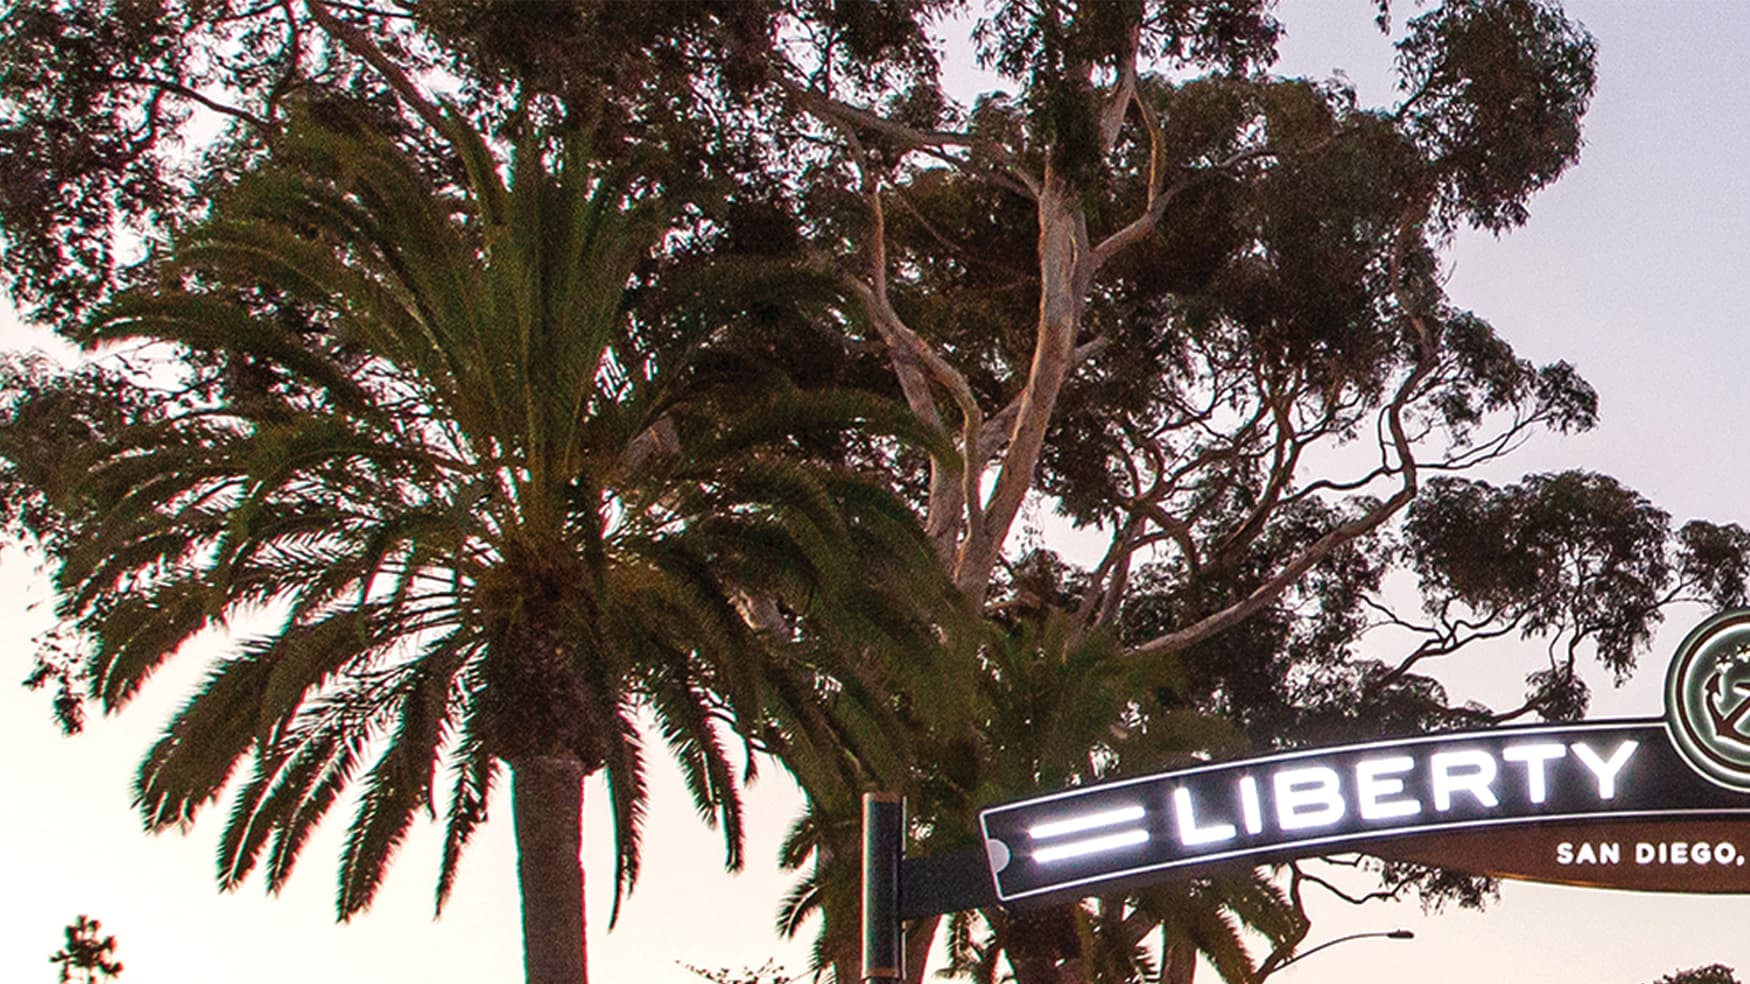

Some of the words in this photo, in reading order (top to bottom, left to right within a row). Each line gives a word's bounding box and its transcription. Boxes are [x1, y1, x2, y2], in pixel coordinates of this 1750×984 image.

[1172, 739, 1640, 847] LIBERTY
[1556, 842, 1620, 865] SAN
[1635, 841, 1745, 867] DIEGO,
